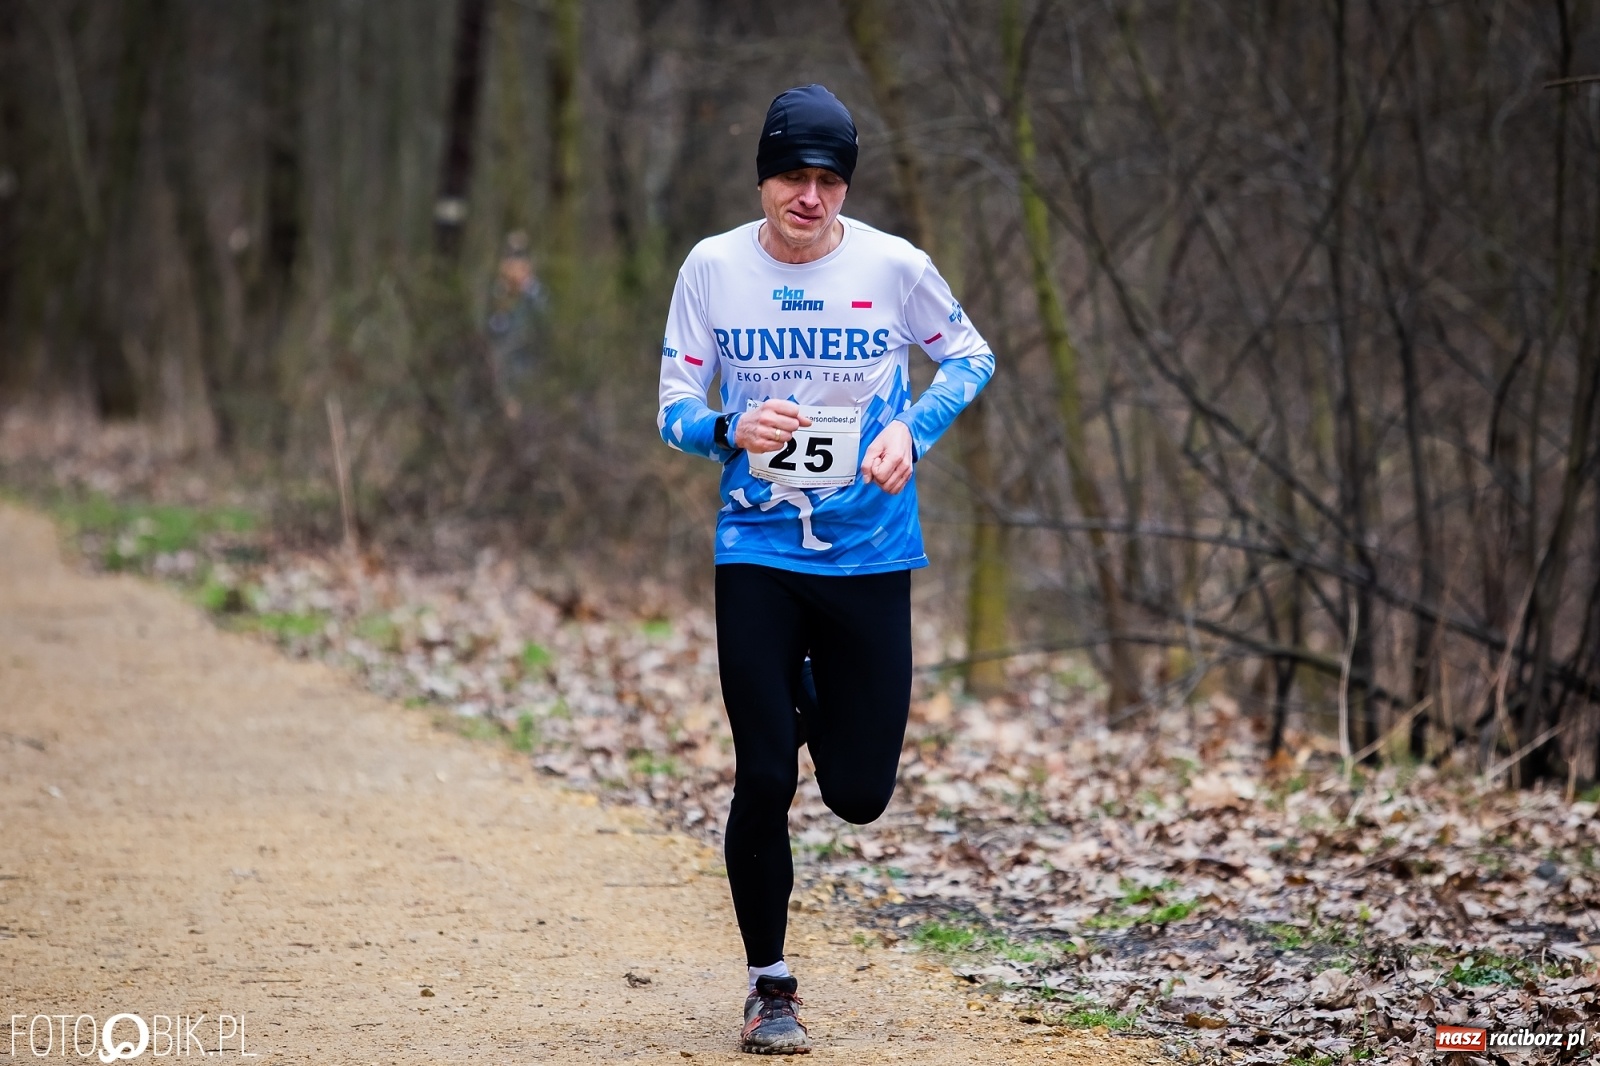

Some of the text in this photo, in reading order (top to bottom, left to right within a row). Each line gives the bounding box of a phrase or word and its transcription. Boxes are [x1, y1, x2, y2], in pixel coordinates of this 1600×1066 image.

[772, 285, 805, 301] eko
[781, 300, 825, 311] okna
[713, 327, 890, 362] RUNNERS
[737, 369, 865, 383] EKO-OKNA TEAM
[768, 436, 834, 474] 25
